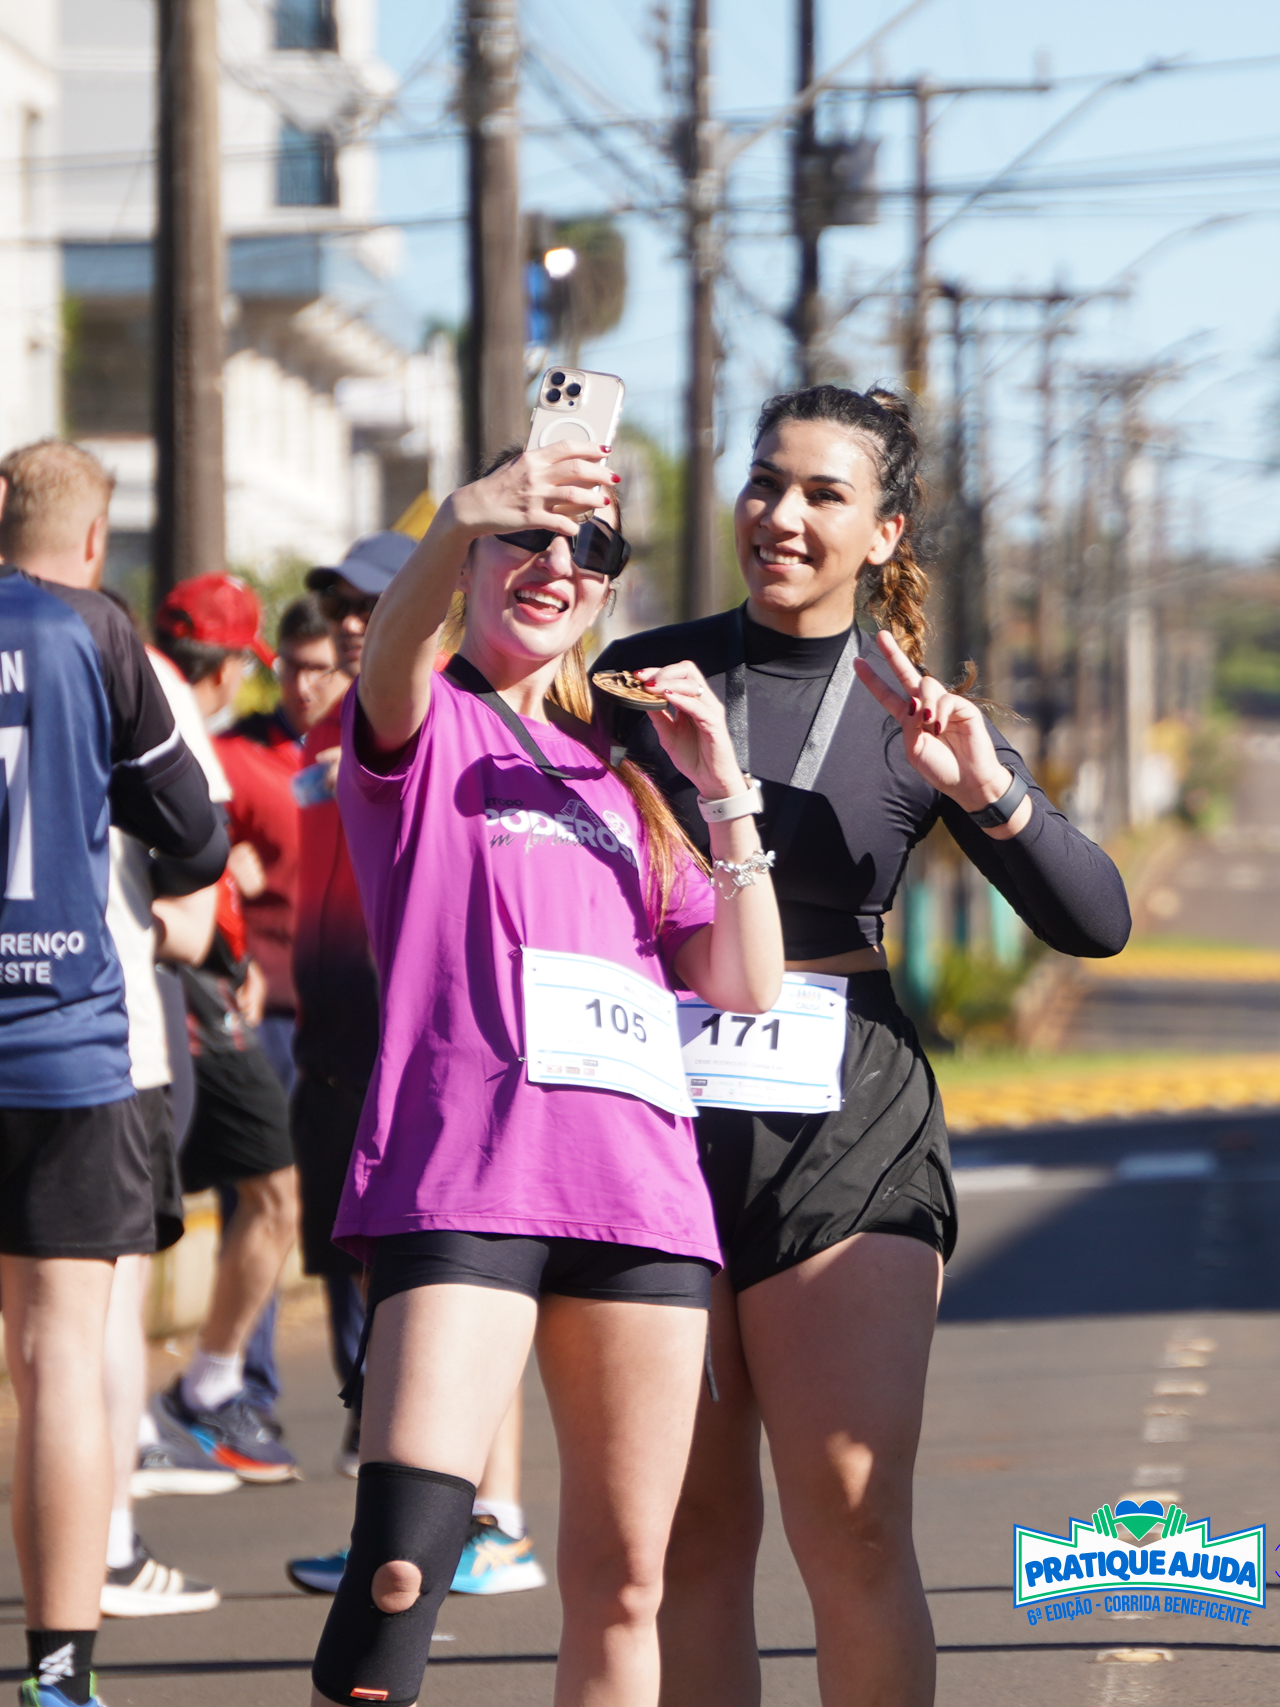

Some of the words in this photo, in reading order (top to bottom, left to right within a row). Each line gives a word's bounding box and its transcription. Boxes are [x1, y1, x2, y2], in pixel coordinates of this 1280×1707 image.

[0, 650, 25, 695] N
[0, 961, 51, 985] STE
[585, 998, 647, 1043] 105
[701, 1013, 780, 1050] 171
